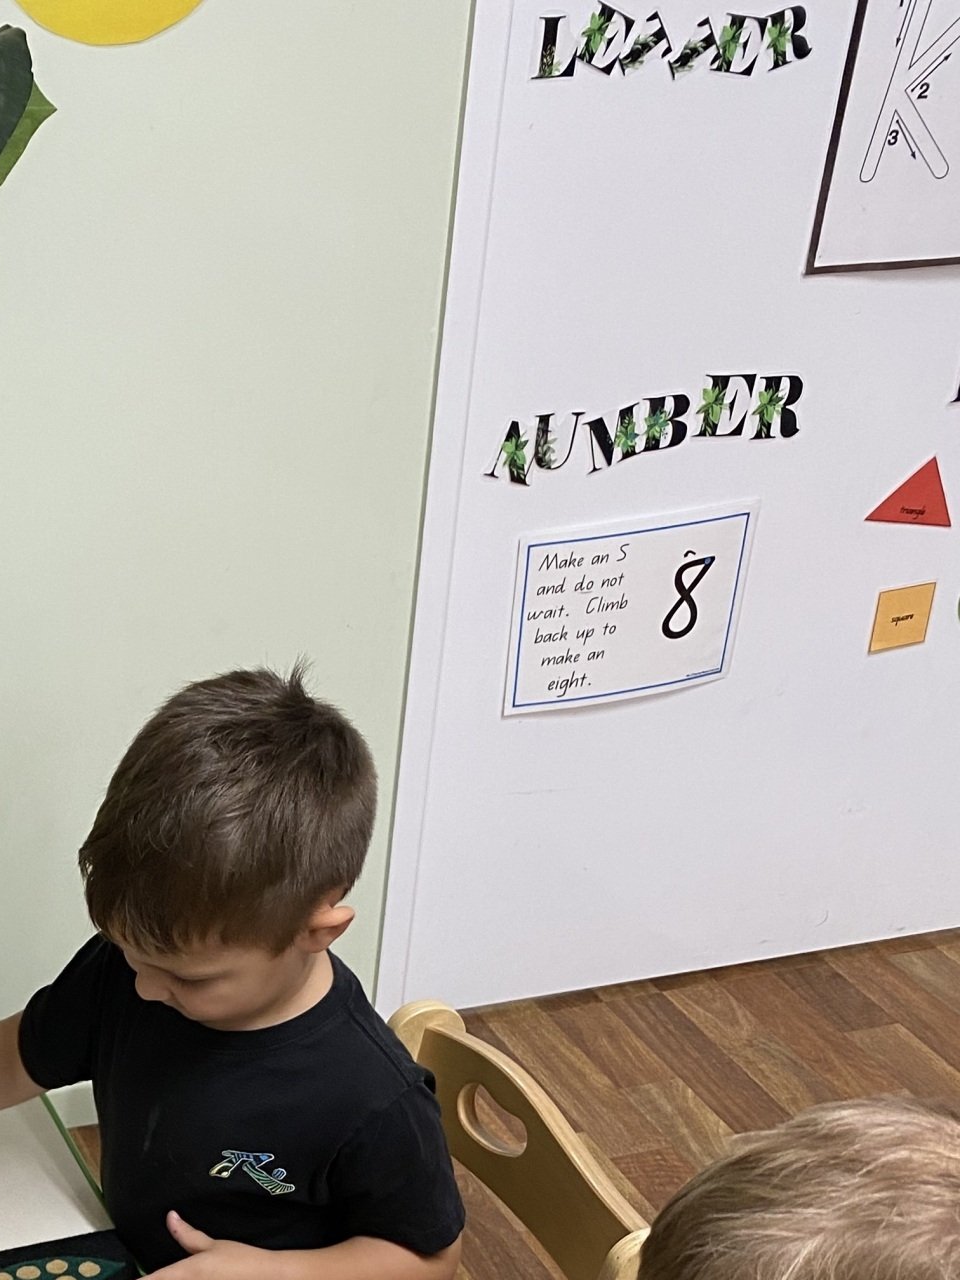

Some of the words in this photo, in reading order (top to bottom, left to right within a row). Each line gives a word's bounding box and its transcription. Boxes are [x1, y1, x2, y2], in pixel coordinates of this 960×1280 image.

[531, 0, 812, 81] LETTER
[917, 82, 930, 99] 2
[887, 130, 899, 146] 3
[539, 551, 584, 571] Make
[591, 554, 609, 566] an
[616, 543, 630, 562] S
[536, 577, 566, 596] and
[574, 574, 594, 592] do
[600, 572, 625, 588] not
[526, 605, 570, 621] wait.
[585, 593, 628, 614] Climb
[661, 555, 715, 640] 8
[534, 625, 568, 644] back
[576, 629, 595, 646] up
[603, 622, 617, 636] to
[541, 648, 580, 667] make
[587, 649, 605, 661] an
[547, 670, 592, 698] eight.
